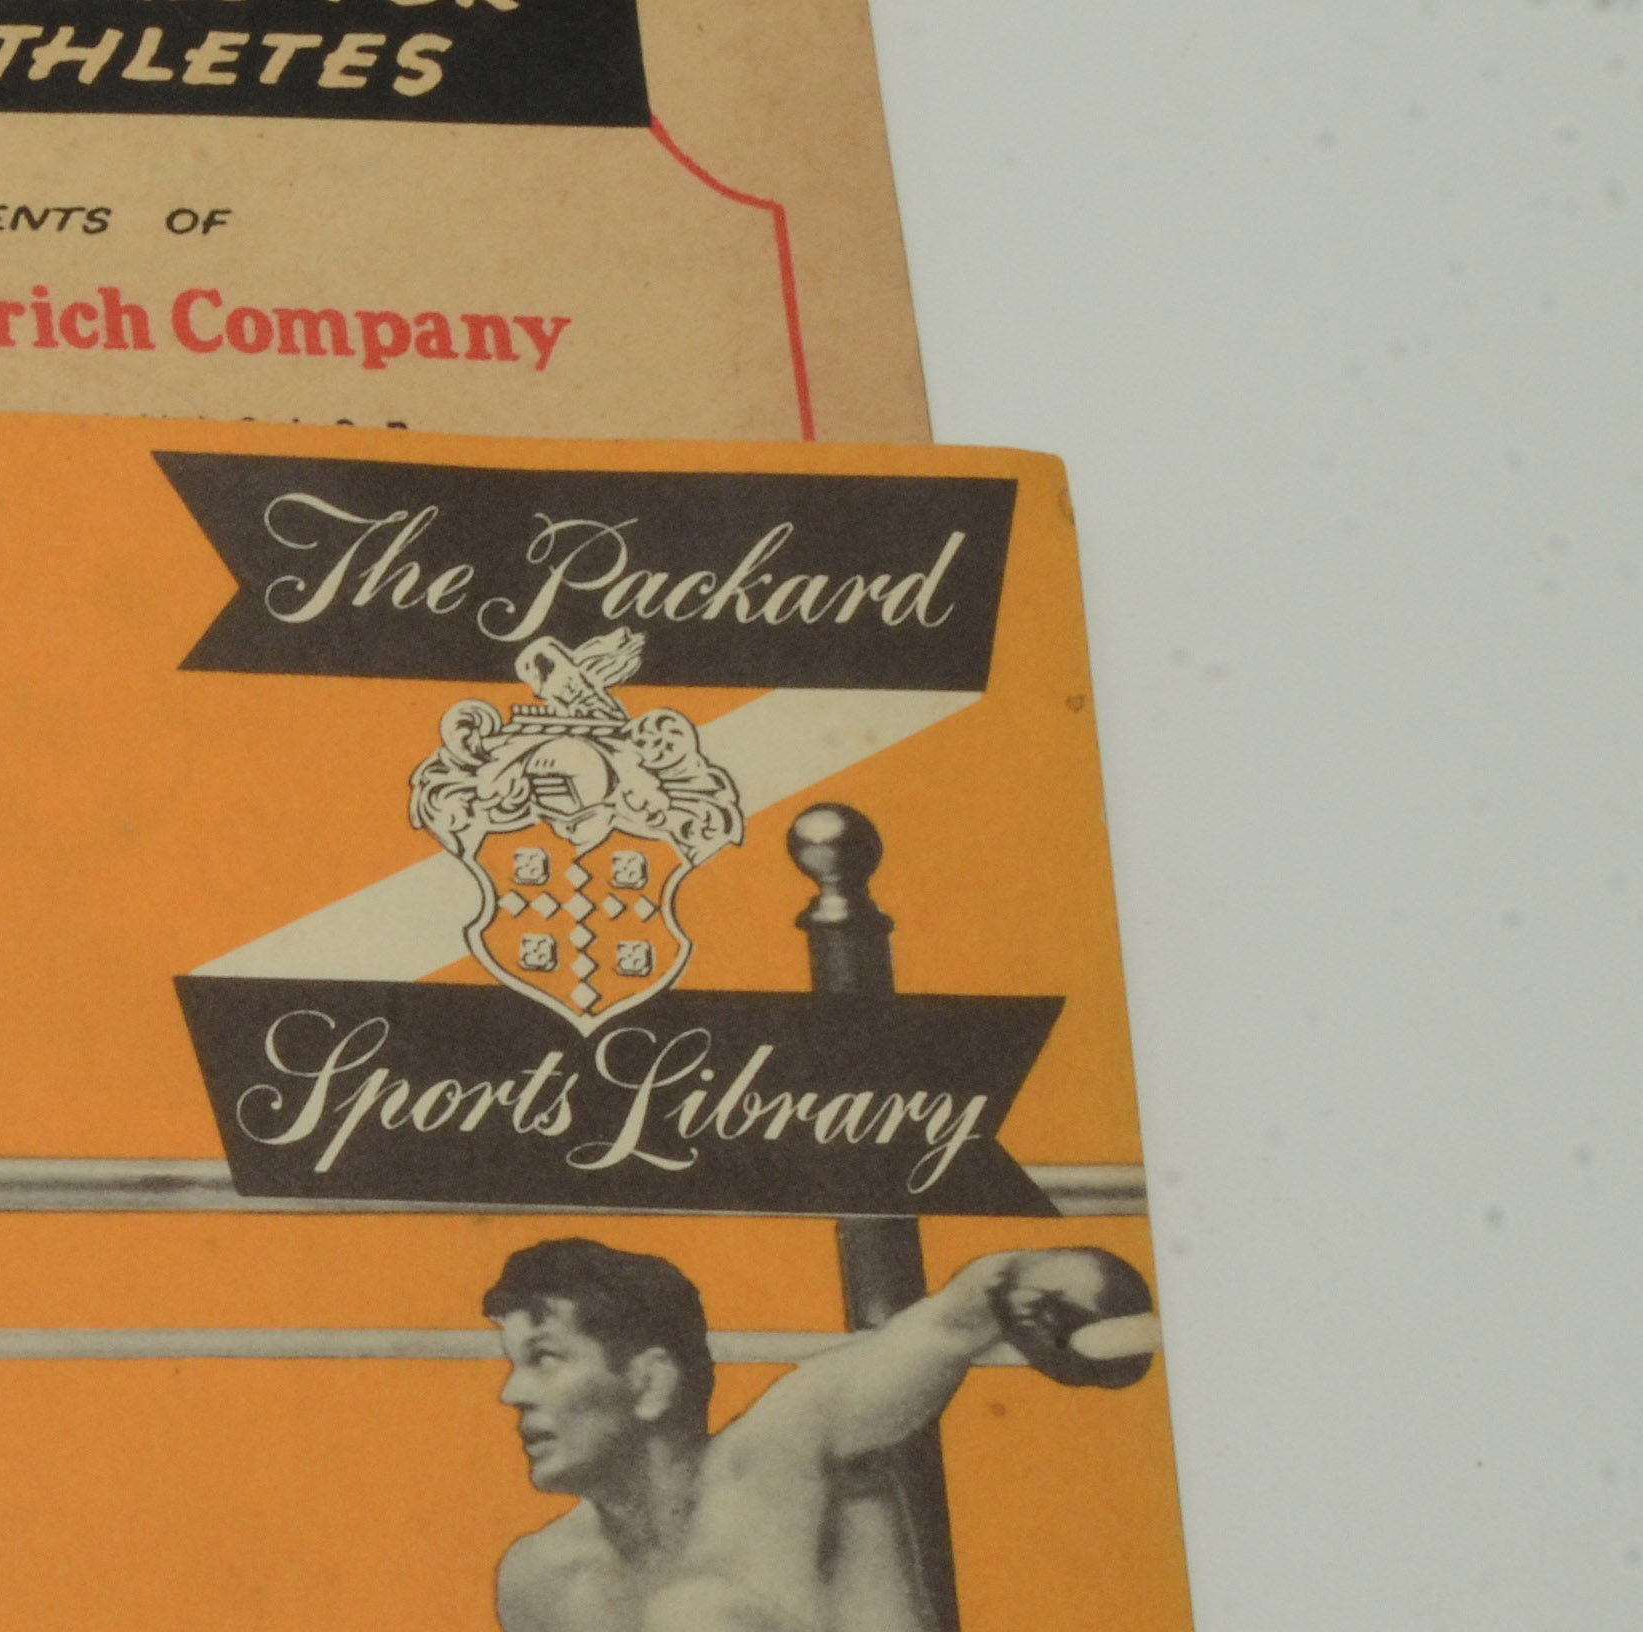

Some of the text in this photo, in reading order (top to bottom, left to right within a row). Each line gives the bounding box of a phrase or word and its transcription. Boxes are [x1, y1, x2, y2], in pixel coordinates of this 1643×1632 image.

[165, 207, 233, 236] OF
[171, 287, 573, 372] Company
[263, 492, 965, 642] The Packard
[236, 1010, 986, 1194] Sports Library
